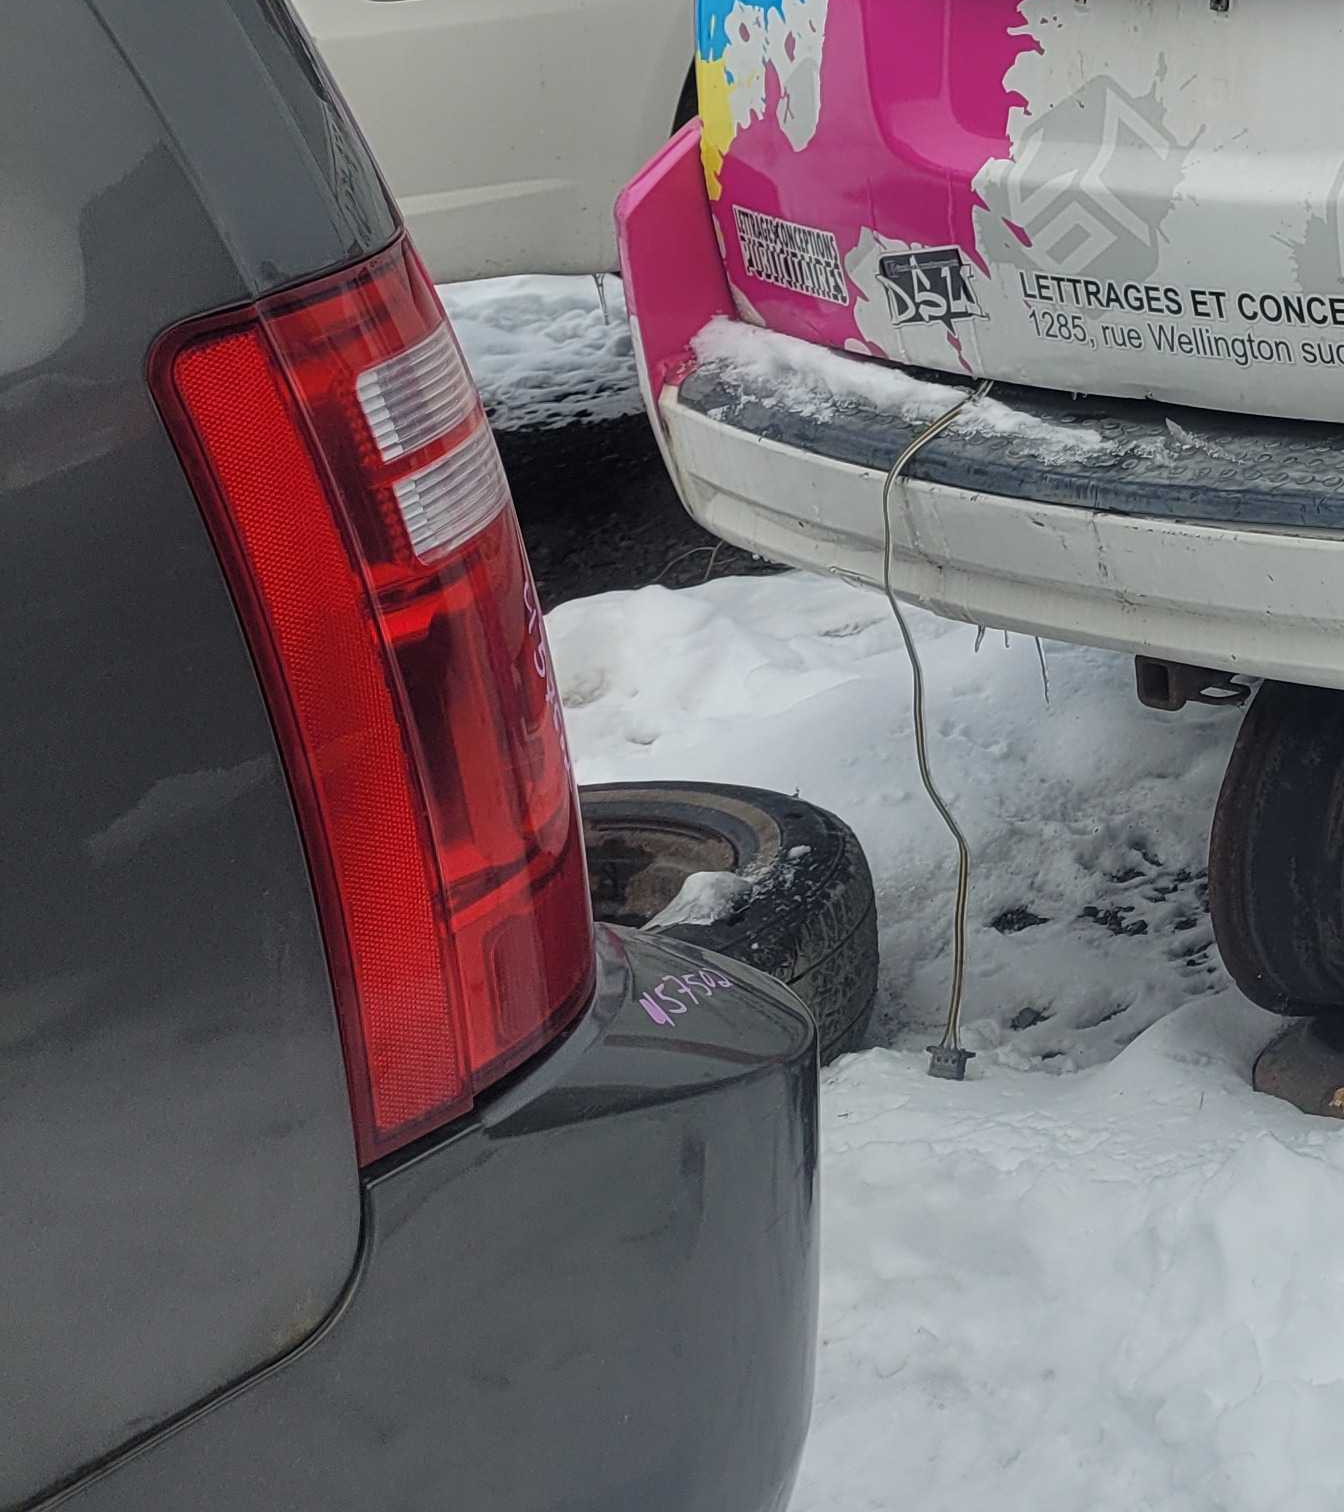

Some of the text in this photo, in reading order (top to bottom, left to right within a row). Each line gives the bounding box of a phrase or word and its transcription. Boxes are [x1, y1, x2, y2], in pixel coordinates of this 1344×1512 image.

[1019, 271, 1183, 317] LETTRAGES
[1192, 289, 1226, 320] ET
[1028, 310, 1096, 349] 1285,
[1101, 321, 1143, 351] rue
[1148, 323, 1293, 367] Wellington
